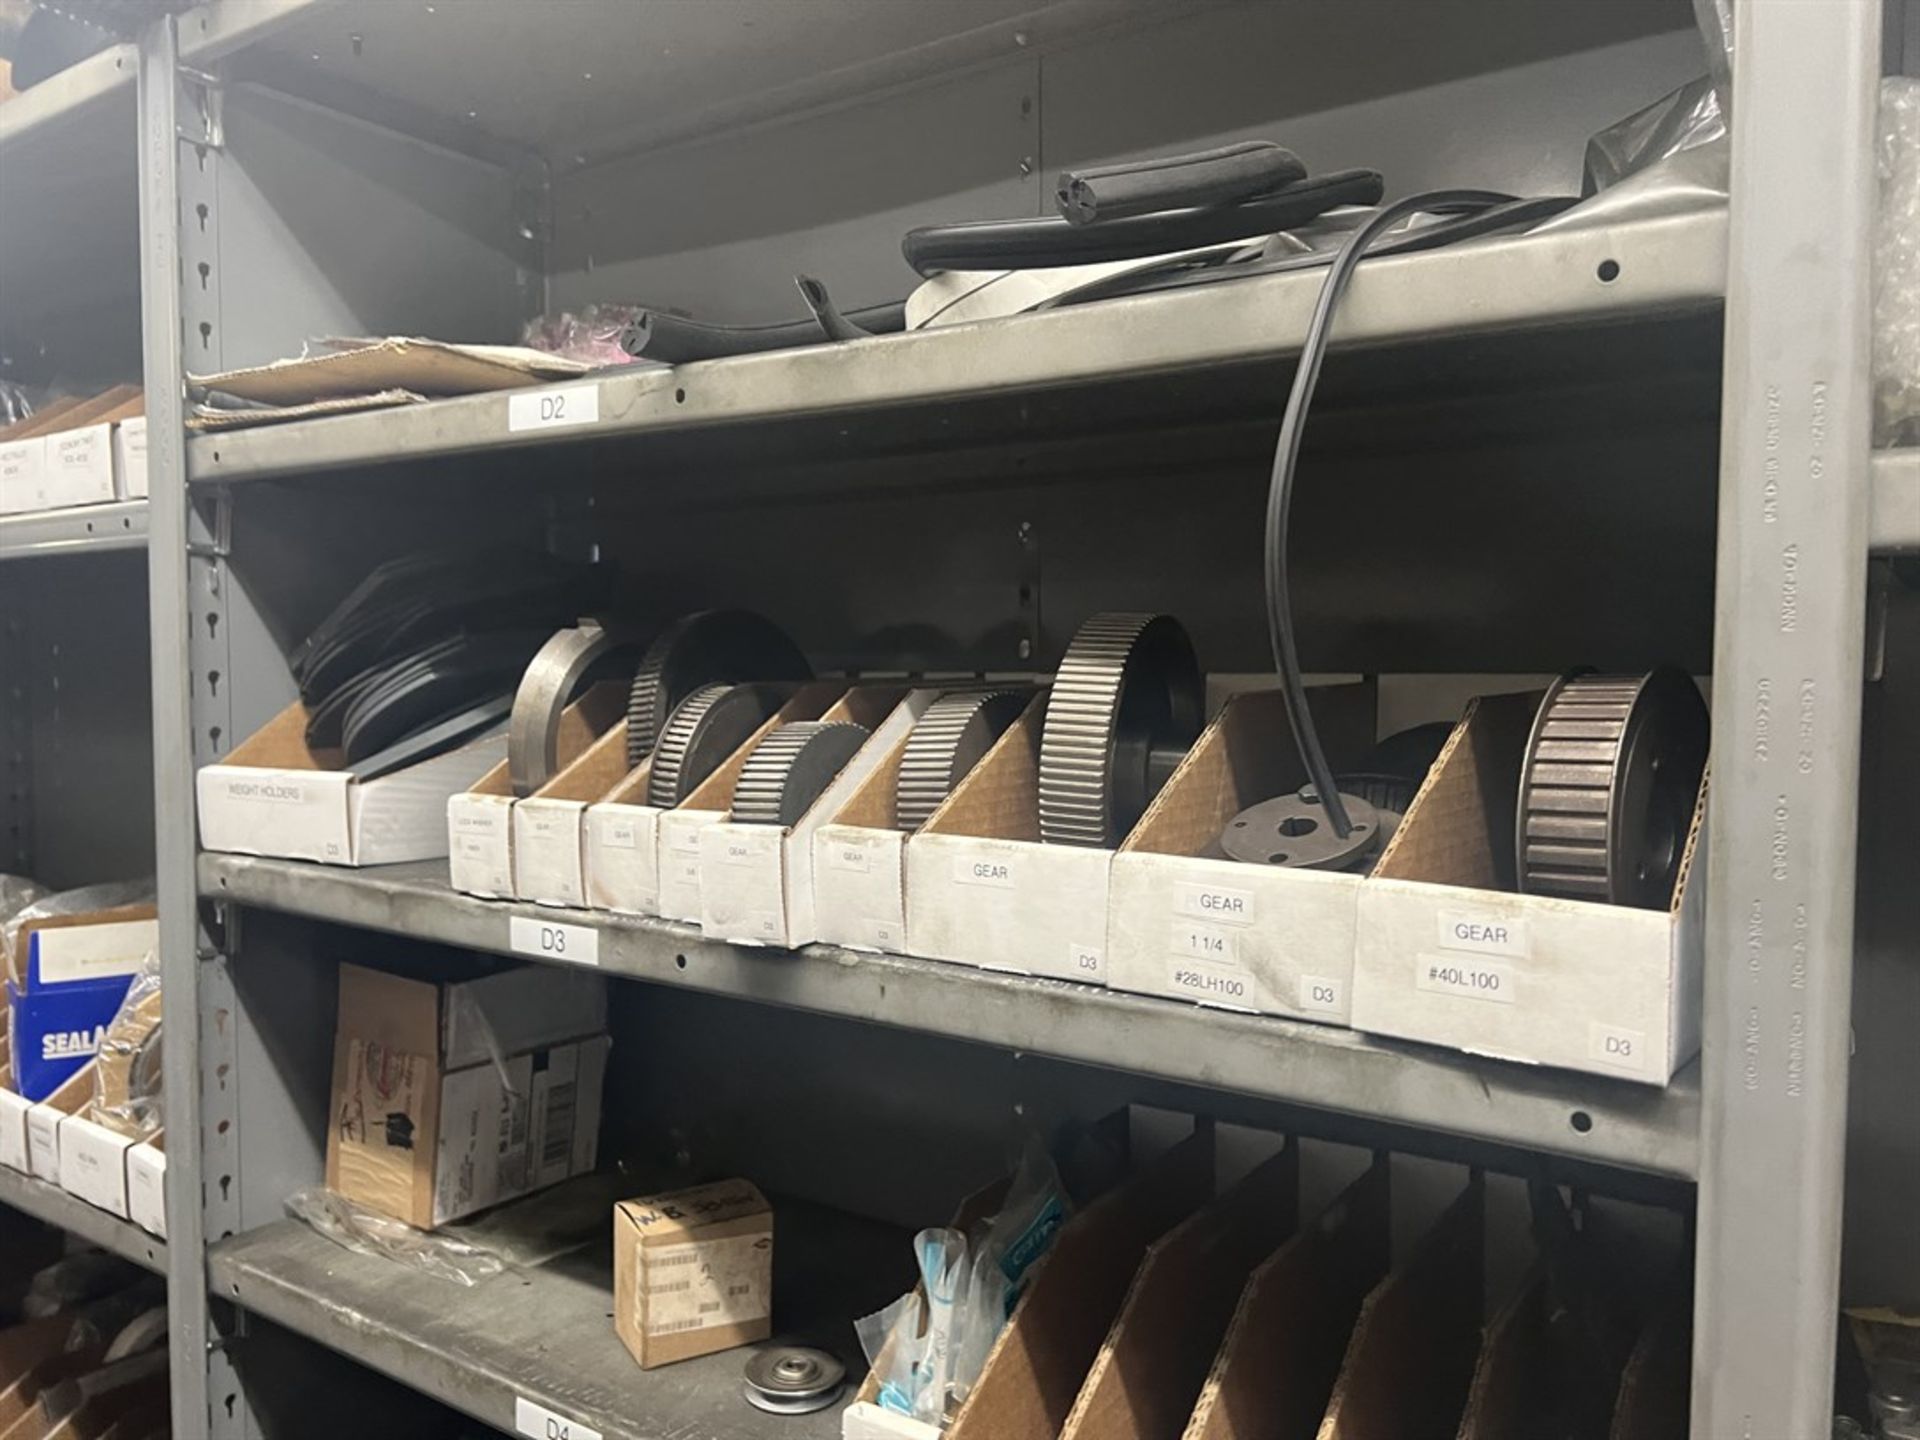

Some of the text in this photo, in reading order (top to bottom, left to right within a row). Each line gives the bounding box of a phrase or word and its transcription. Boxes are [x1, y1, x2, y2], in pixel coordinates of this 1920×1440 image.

[541, 395, 565, 421] D2
[260, 785, 300, 801] HOLDERS
[973, 862, 1009, 880] GEAR
[1199, 893, 1244, 913] GEAR
[541, 927, 566, 953] D3
[1454, 922, 1509, 944] GEAR
[1202, 937, 1223, 953] 1/4
[1078, 954, 1097, 971] D3
[1174, 969, 1244, 997] #28LH100
[1428, 966, 1501, 991] #40L100
[1312, 985, 1335, 1003] D3
[1604, 1036, 1632, 1057] D3
[546, 1417, 569, 1440] D4
